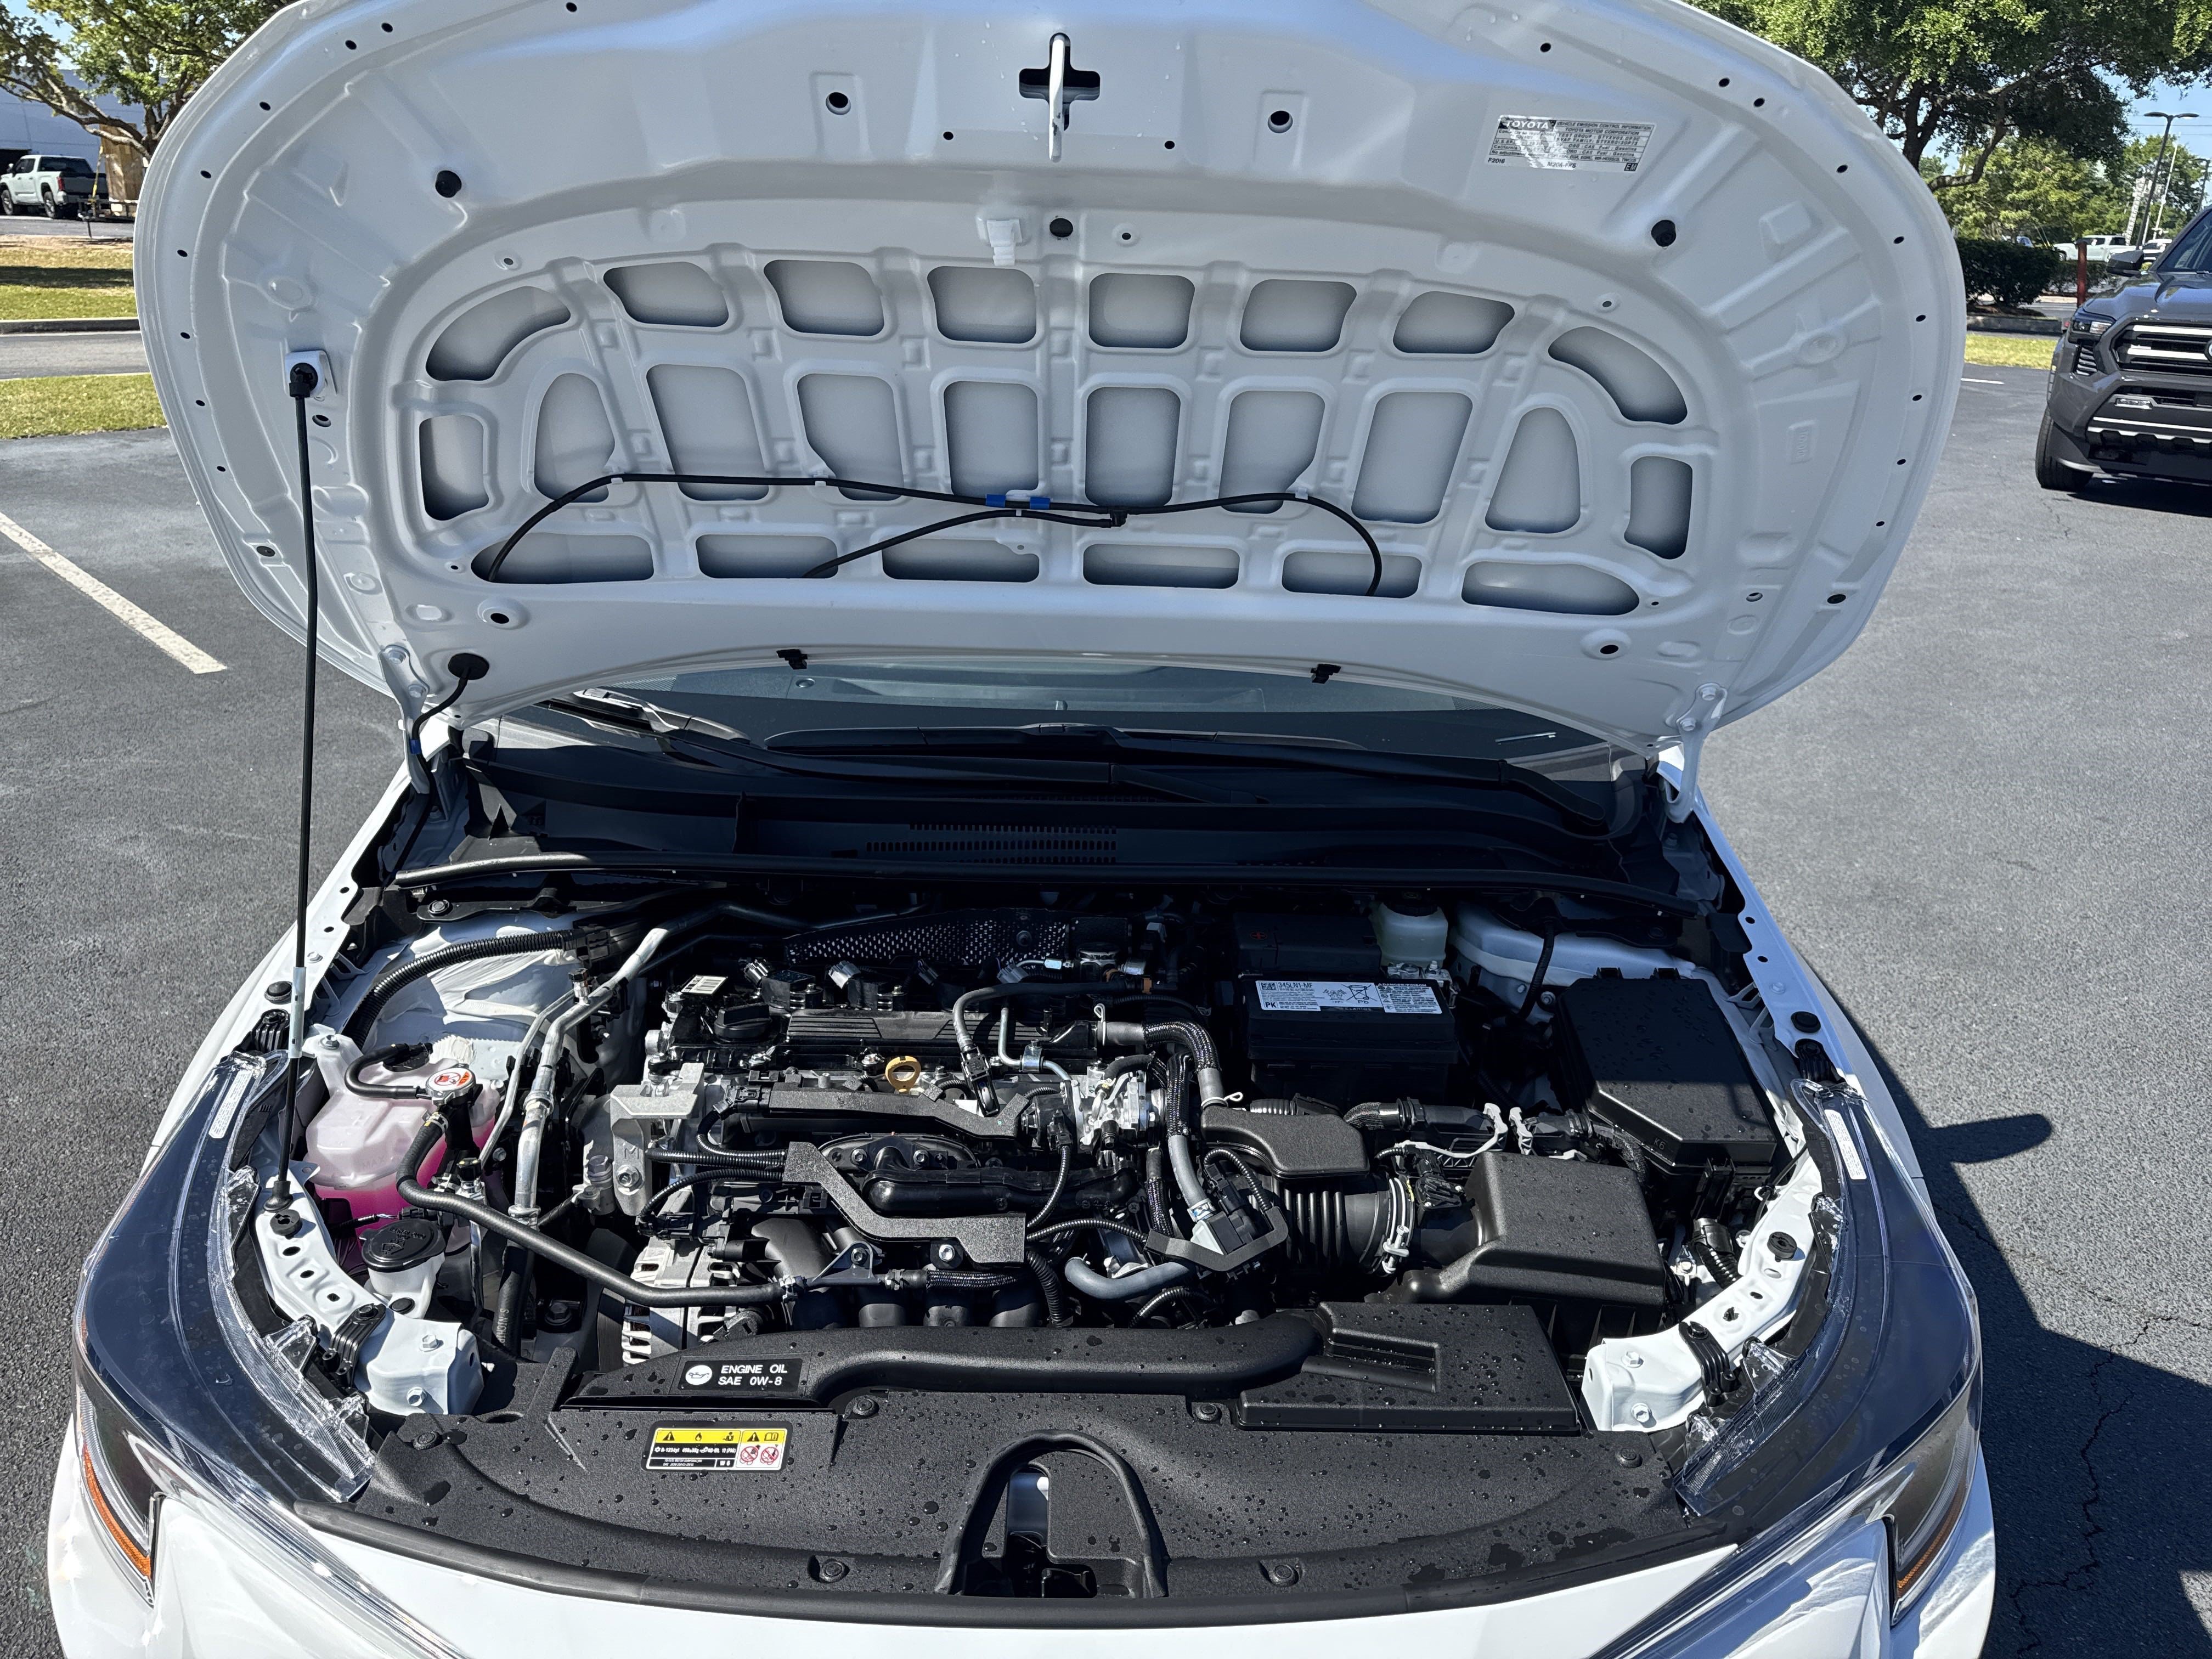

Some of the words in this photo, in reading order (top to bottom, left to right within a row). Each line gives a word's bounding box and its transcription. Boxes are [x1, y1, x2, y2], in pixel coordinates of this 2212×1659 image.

[1505, 120, 1550, 129] TOYOTA
[1654, 1137, 1667, 1150] K6
[721, 1364, 763, 1374] ENGINE
[769, 1364, 788, 1373] OIL
[718, 1376, 742, 1385] SAE
[749, 1376, 782, 1386] 0W-8
